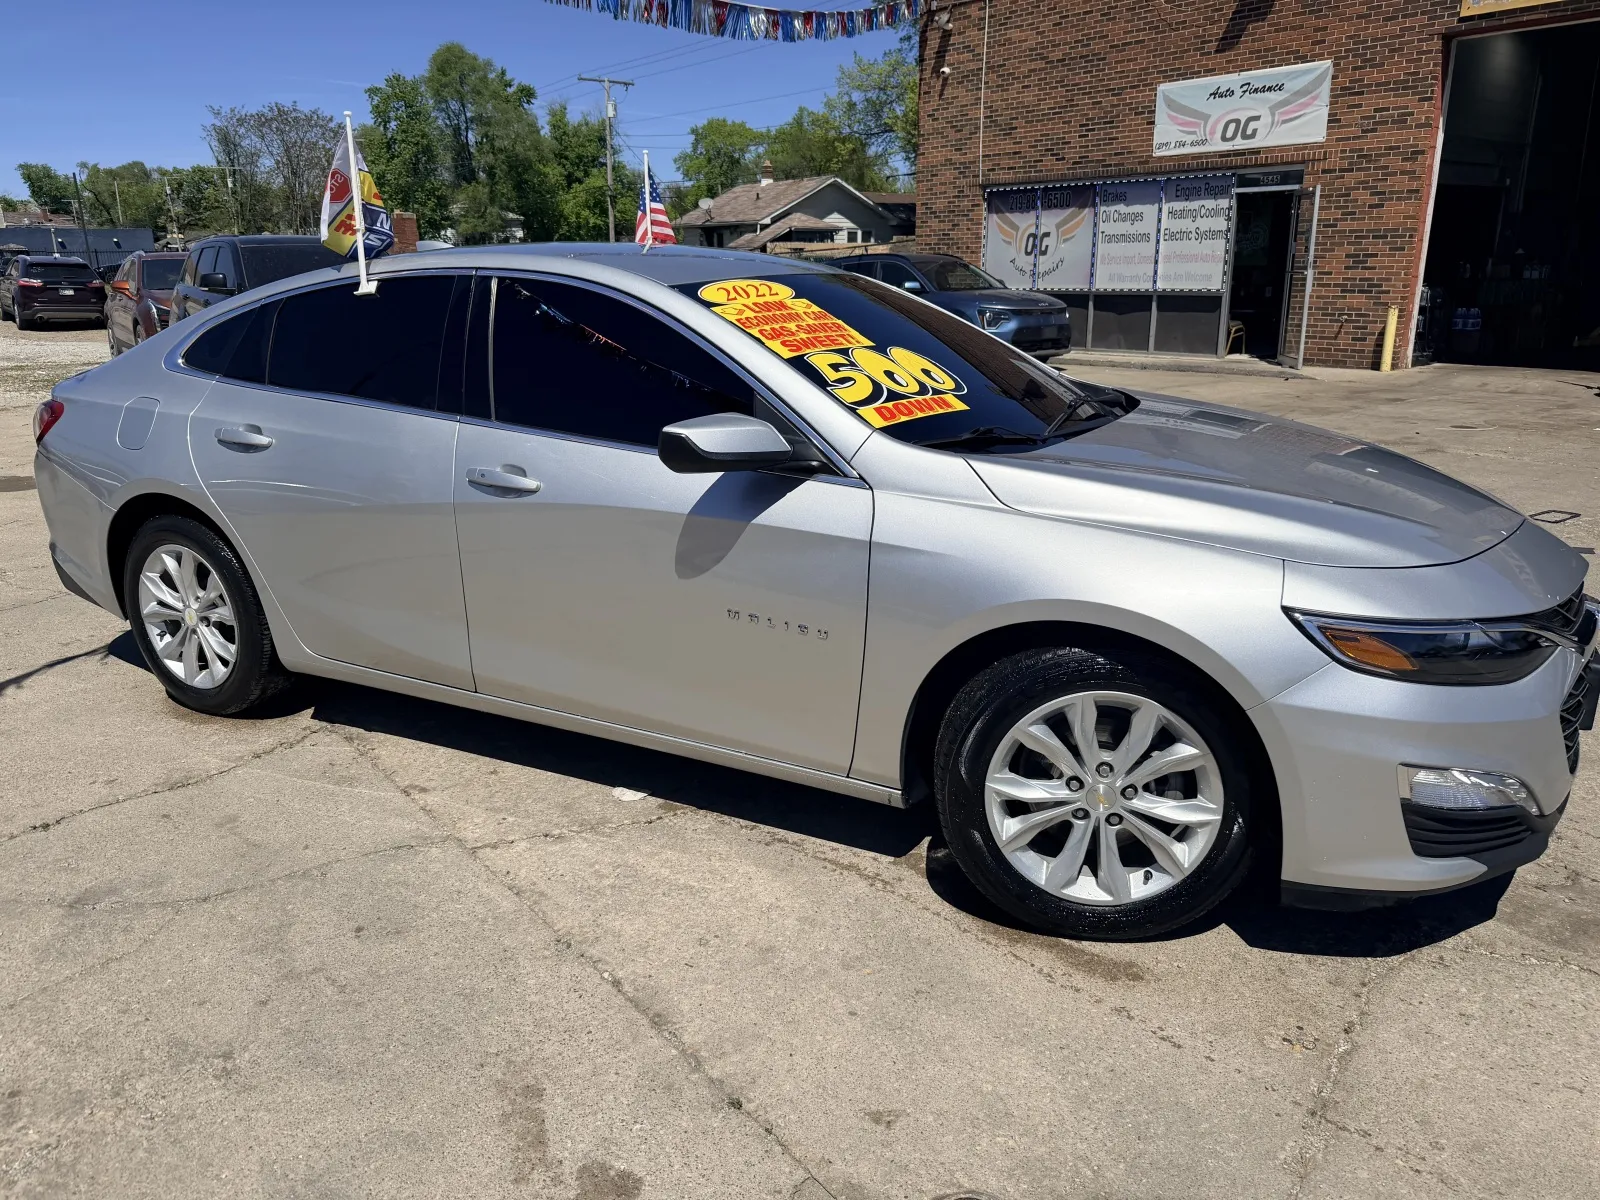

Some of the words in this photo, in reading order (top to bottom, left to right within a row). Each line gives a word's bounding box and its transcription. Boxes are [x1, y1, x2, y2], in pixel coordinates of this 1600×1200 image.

[1206, 86, 1235, 101] Auto
[1237, 82, 1285, 99] Finance
[1220, 115, 1261, 142] OG
[1173, 139, 1207, 149] 884-6500
[1260, 175, 1280, 185] 4545
[1102, 189, 1127, 203] Brakes
[1175, 183, 1201, 201] Engine
[1203, 181, 1231, 199] Repair
[1101, 209, 1112, 224] Oil
[1112, 209, 1144, 225] Changes
[1167, 204, 1230, 223] Heating/Cooling
[1024, 232, 1051, 256] OG
[1100, 230, 1151, 244] Transmissions
[1163, 227, 1193, 242] Electric
[1194, 226, 1228, 244] Systems
[1010, 257, 1027, 277] Auto
[1184, 270, 1212, 282] Welcome
[716, 283, 780, 302] 2022
[741, 300, 796, 315] LOOK
[736, 312, 805, 330] ECONOMY
[803, 310, 835, 322] CAR
[780, 333, 863, 353] SWEET!
[804, 346, 968, 409] 500
[873, 396, 957, 423] DOWN
[726, 608, 829, 641] MALIBU
